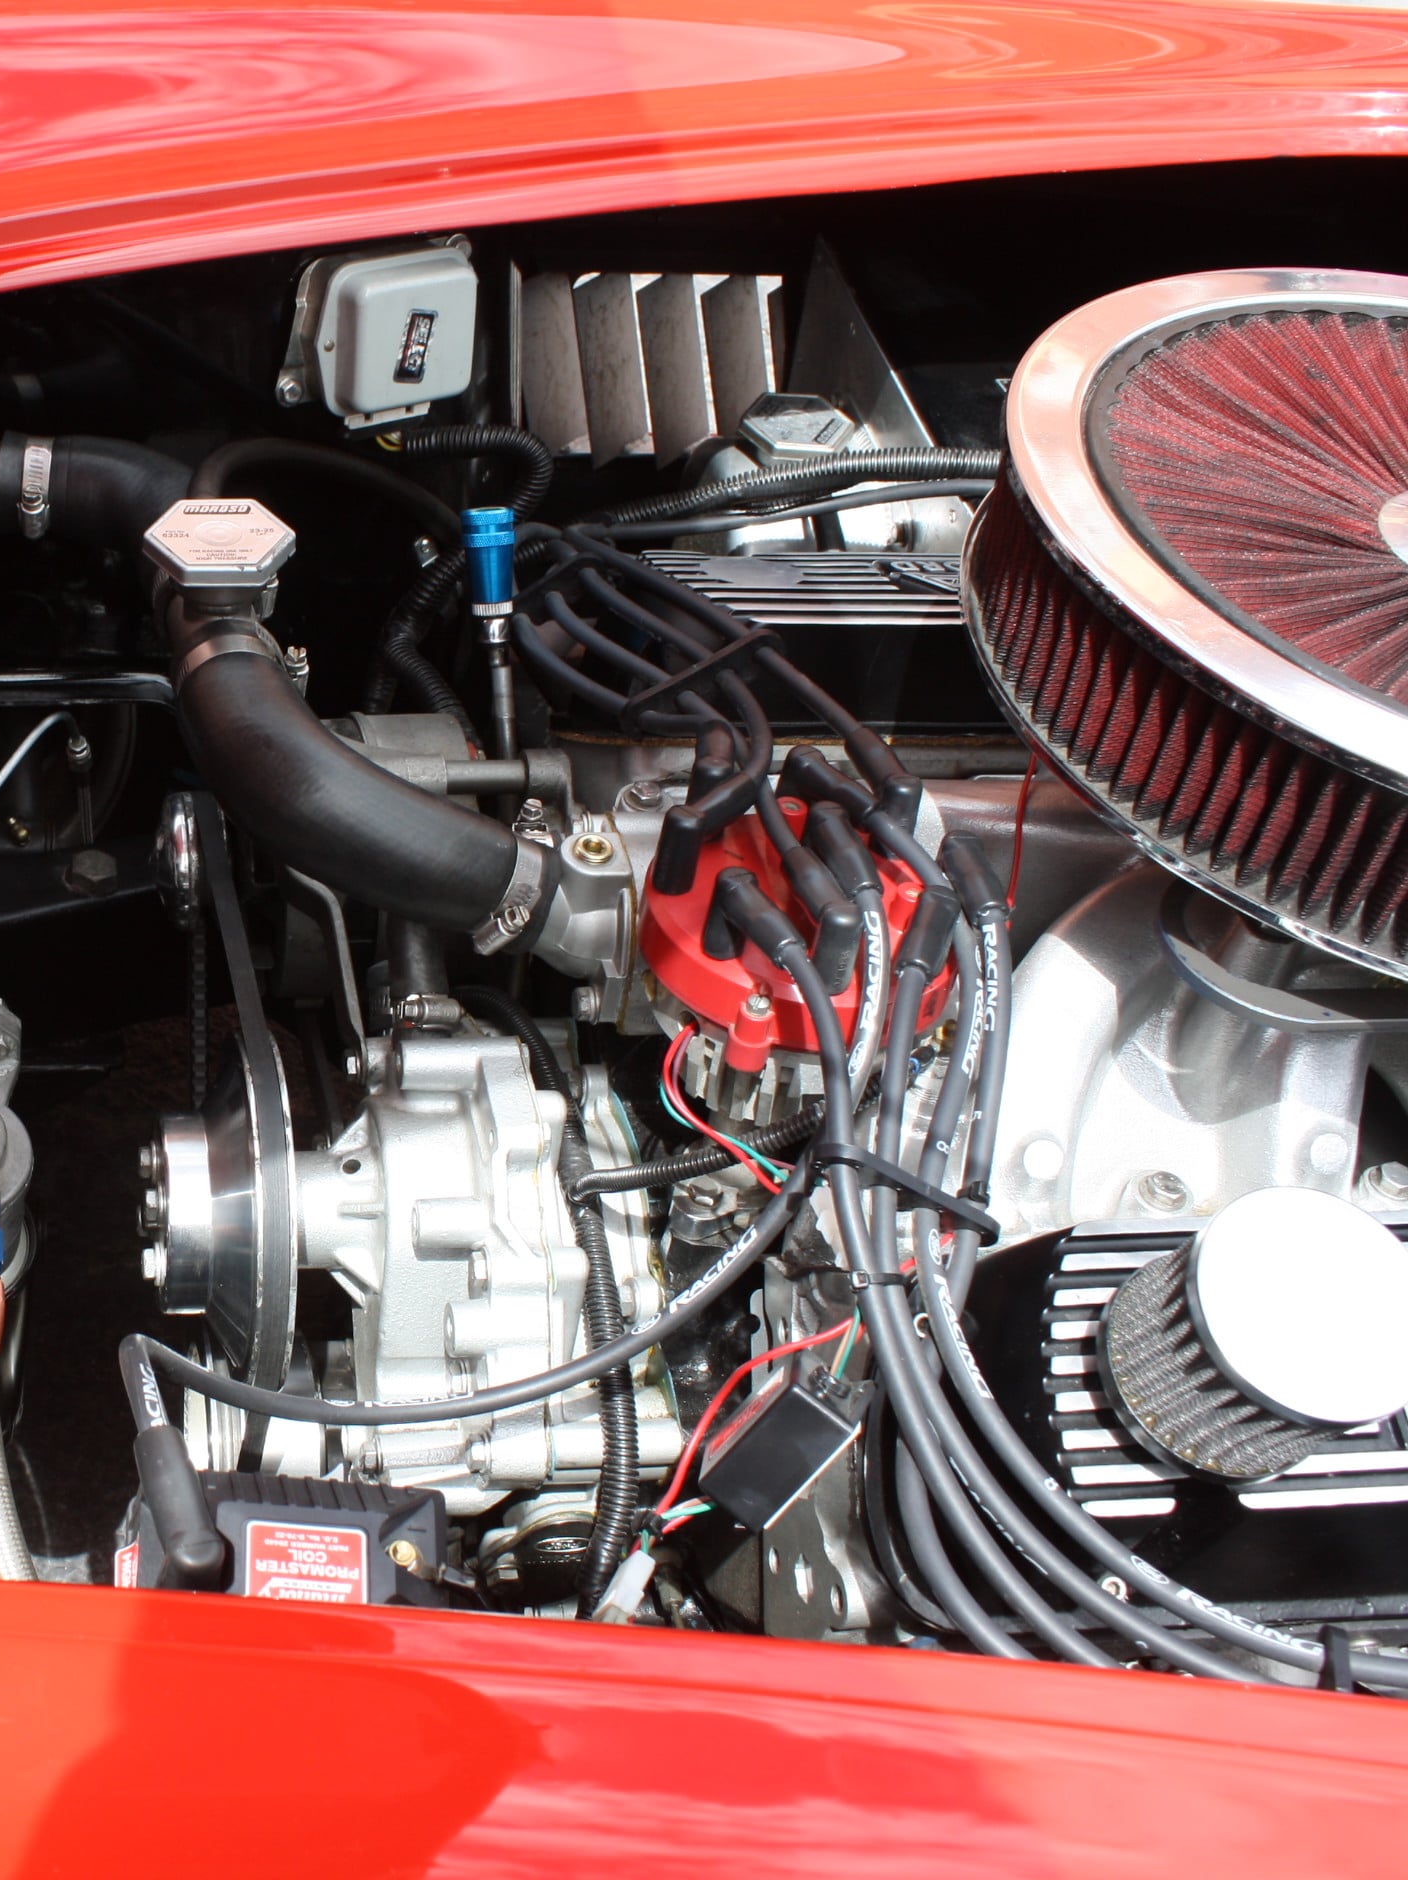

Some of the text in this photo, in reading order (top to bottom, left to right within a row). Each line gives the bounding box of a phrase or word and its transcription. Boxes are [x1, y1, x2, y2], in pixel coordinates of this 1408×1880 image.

[891, 560, 960, 572] ORD
[859, 911, 882, 1033] RACING
[982, 922, 998, 1032] RACING
[669, 1224, 758, 1313] RACING
[933, 1274, 994, 1400] RACING
[255, 1559, 360, 1580] PROMASTER
[287, 1548, 327, 1563] COIL
[1176, 1588, 1324, 1655] RACING
